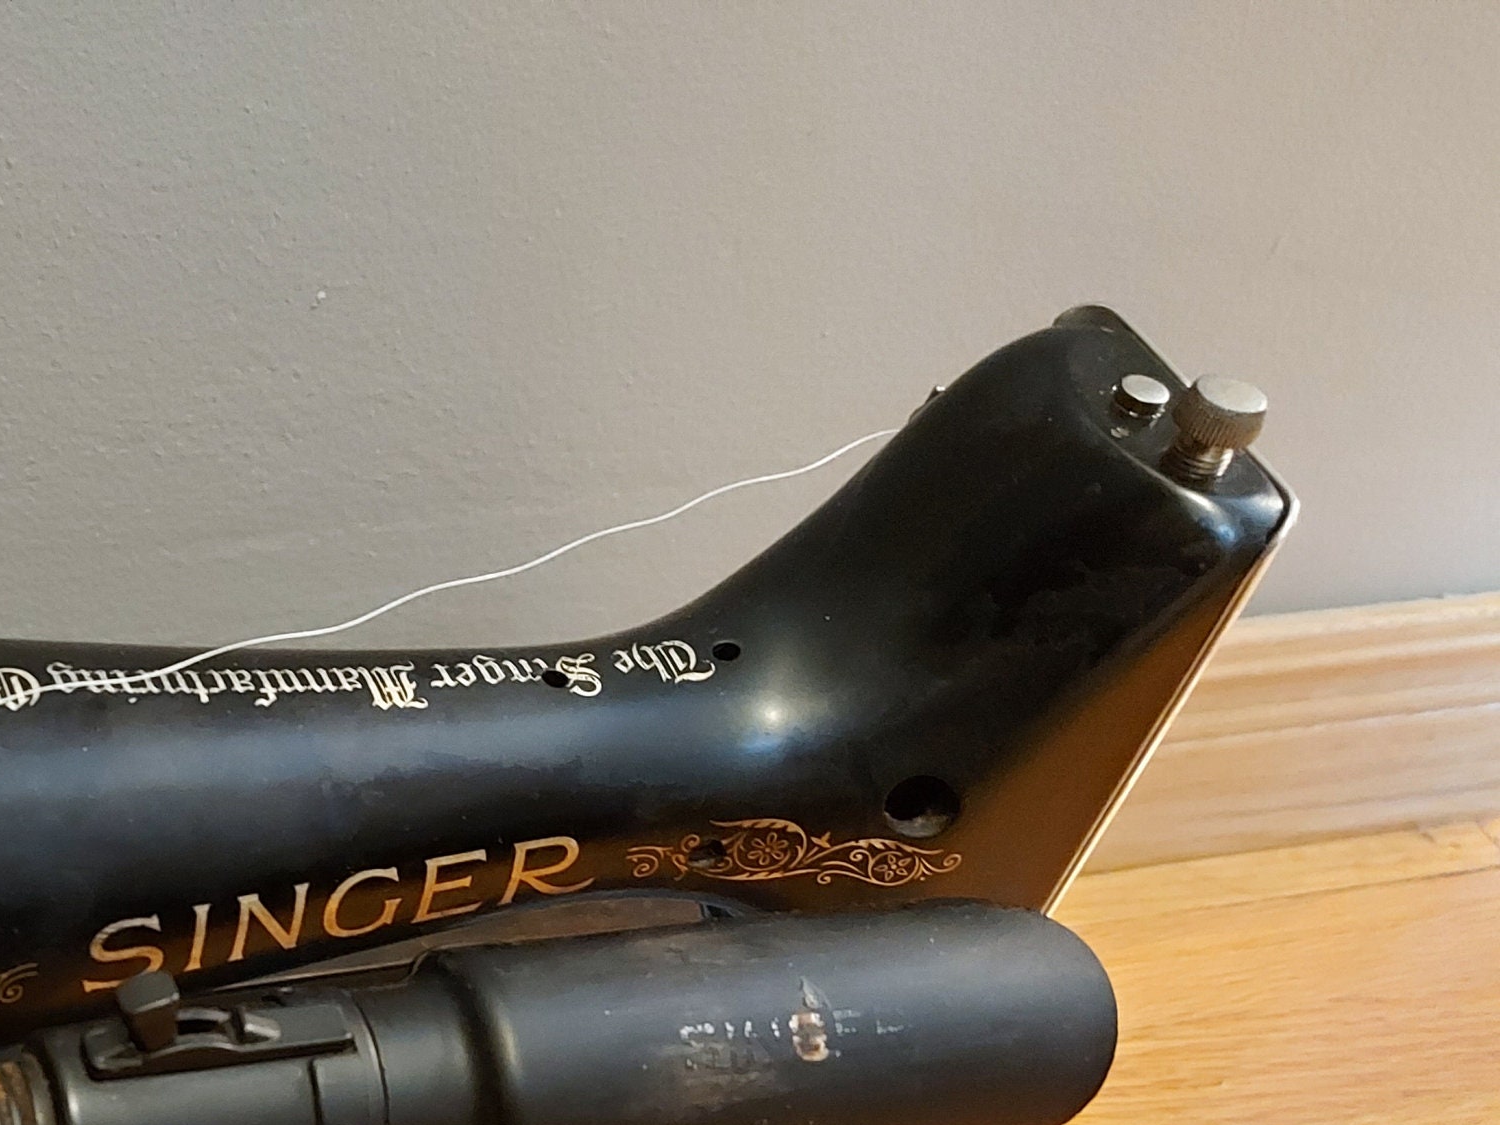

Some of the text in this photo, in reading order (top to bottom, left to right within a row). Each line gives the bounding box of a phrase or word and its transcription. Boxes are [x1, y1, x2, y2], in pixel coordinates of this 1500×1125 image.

[46, 660, 428, 710] Manufacturing
[610, 640, 716, 684] The
[81, 835, 595, 993] SINGER
